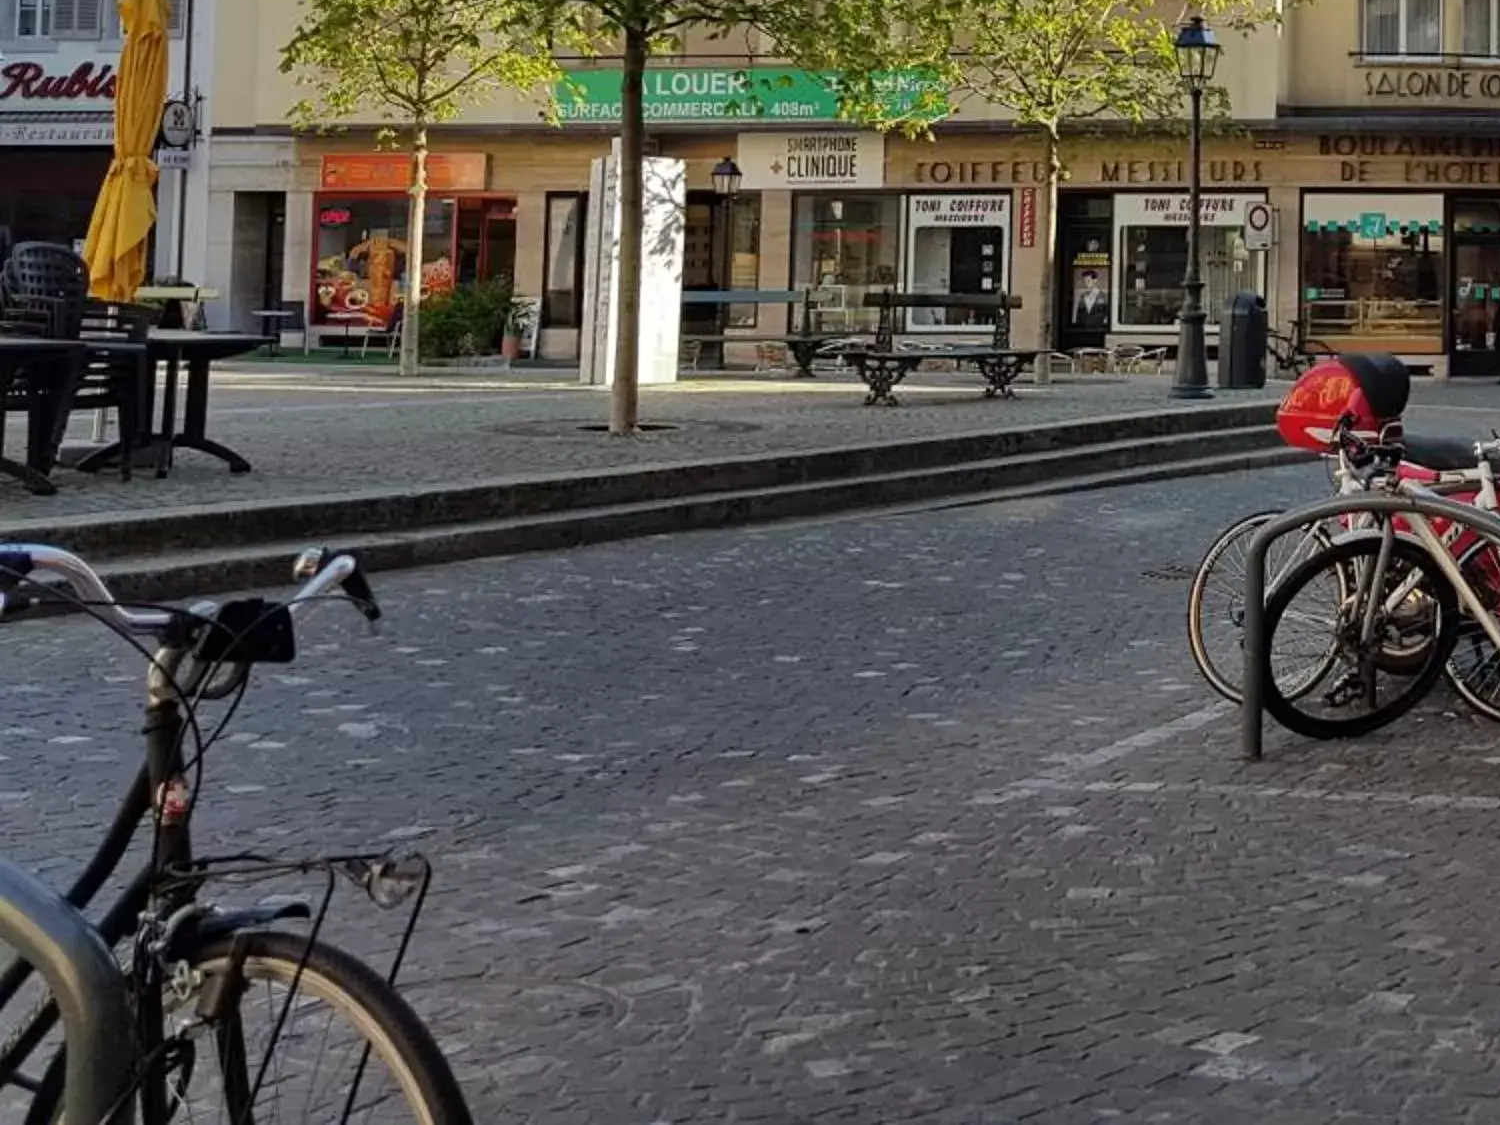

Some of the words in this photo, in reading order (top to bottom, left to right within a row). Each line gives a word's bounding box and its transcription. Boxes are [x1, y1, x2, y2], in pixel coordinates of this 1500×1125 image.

[655, 72, 747, 95] LOUER
[1366, 71, 1441, 98] SALON
[1448, 72, 1472, 99] DE
[557, 102, 622, 117] SURFAC
[642, 101, 761, 117] COMMERCALE
[787, 136, 857, 153] SMARTPHONE
[787, 154, 857, 178] CLINIQUE
[915, 160, 1049, 184] COIFFEU
[1101, 160, 1264, 183] MESSIURS
[1340, 160, 1371, 182] DE
[915, 199, 941, 212] TONI
[949, 198, 1004, 213] COIFFURE
[1144, 198, 1171, 212] TONI
[1179, 198, 1235, 212] COFFURE
